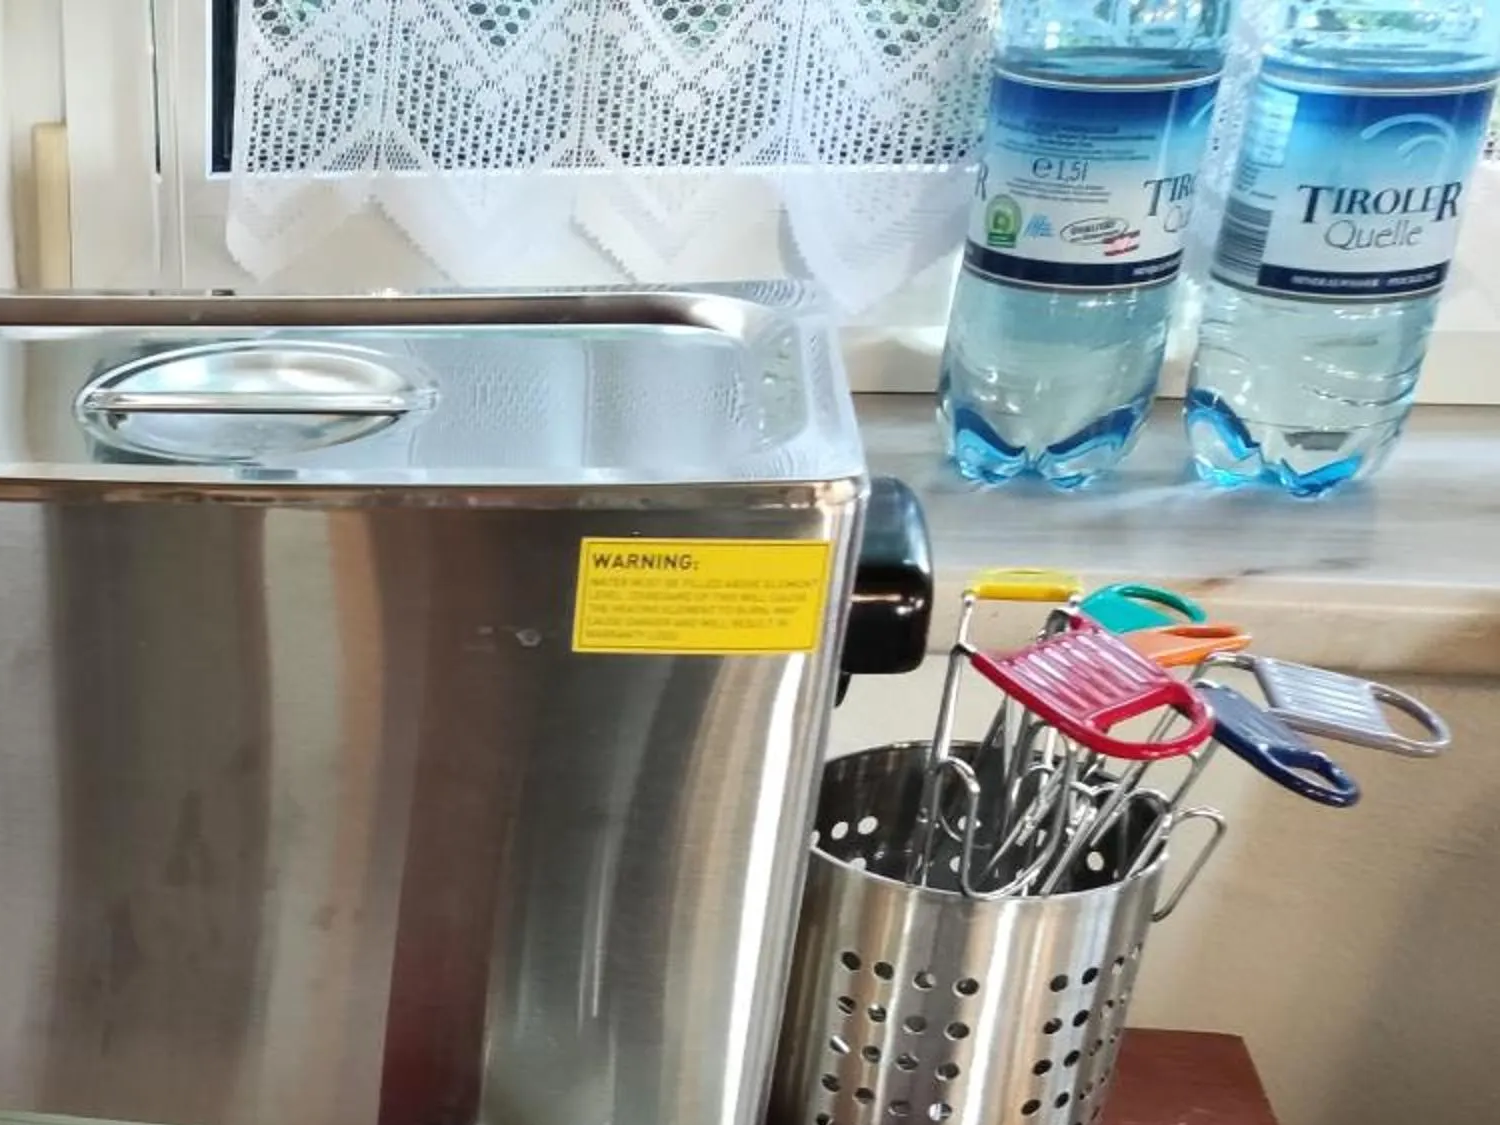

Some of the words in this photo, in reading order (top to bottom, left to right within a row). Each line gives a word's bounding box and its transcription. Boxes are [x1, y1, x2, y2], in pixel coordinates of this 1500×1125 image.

[1297, 181, 1463, 224] TIROLER
[1323, 219, 1423, 250] Quelle
[592, 553, 700, 571] WARNING:
